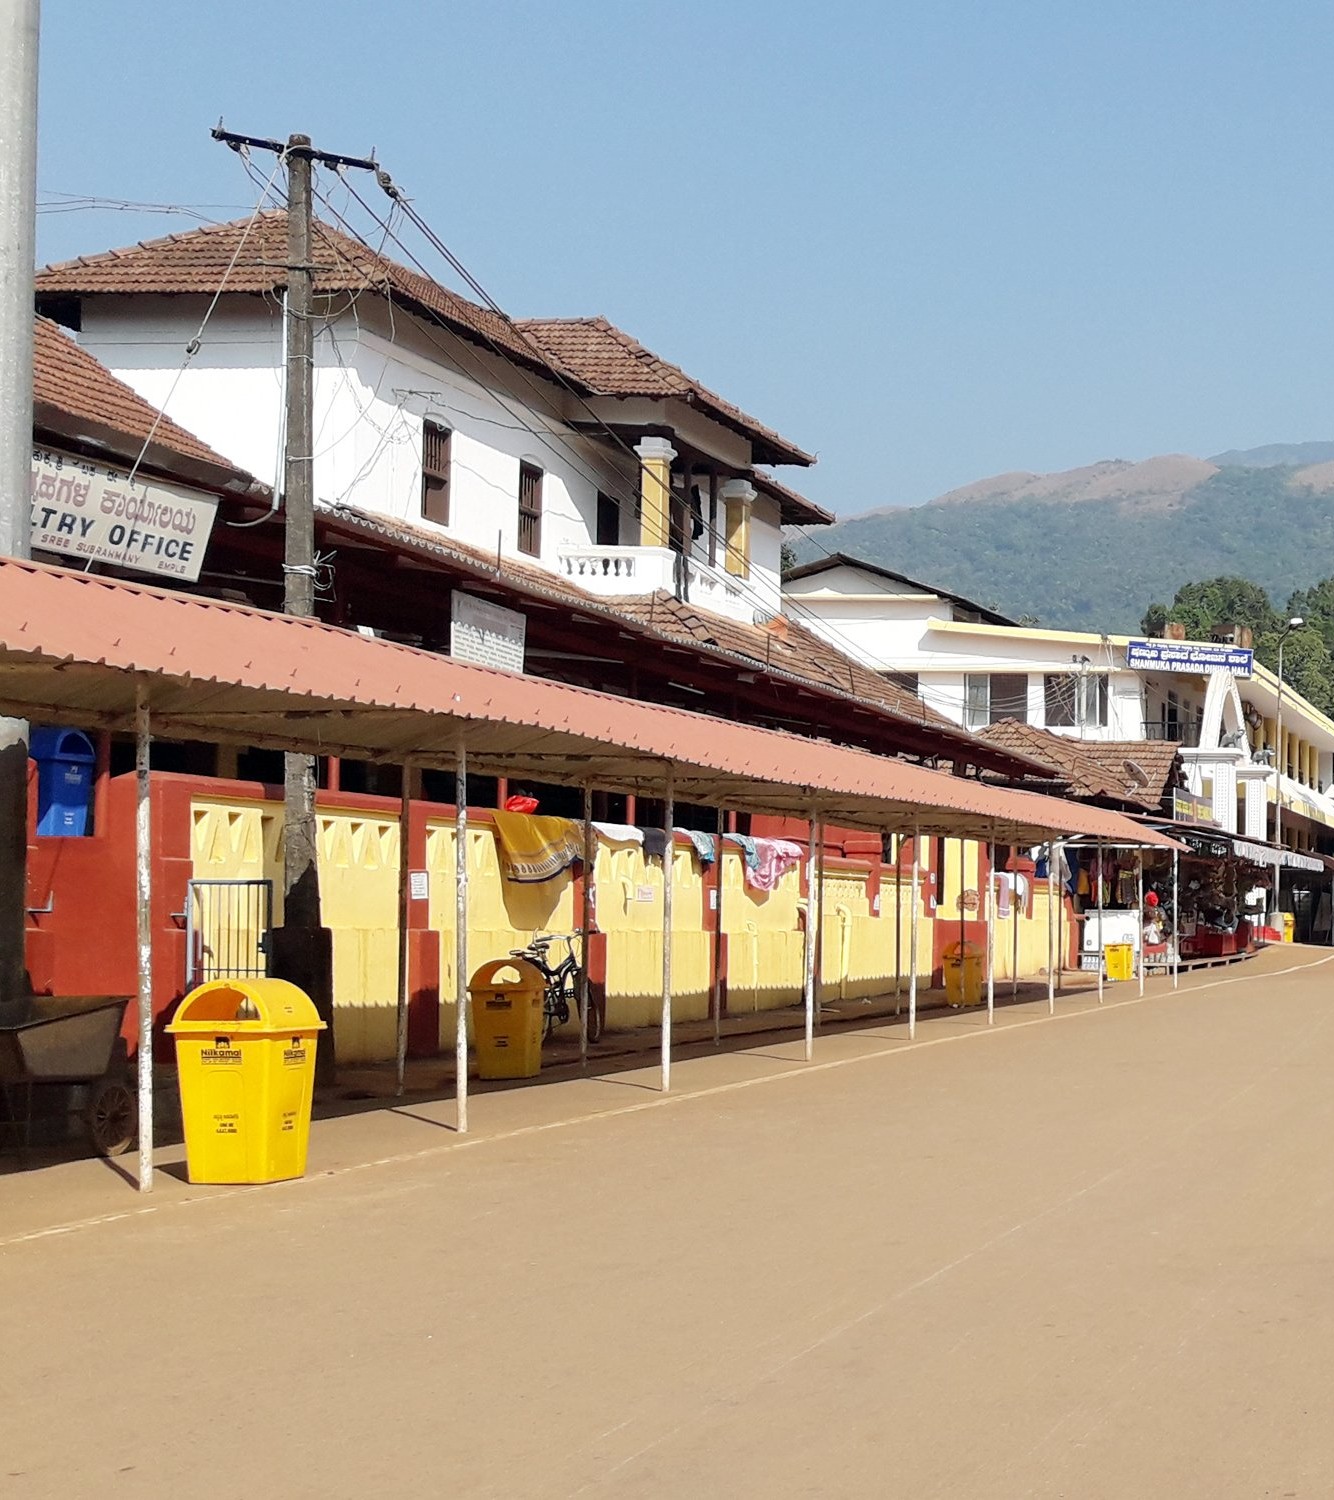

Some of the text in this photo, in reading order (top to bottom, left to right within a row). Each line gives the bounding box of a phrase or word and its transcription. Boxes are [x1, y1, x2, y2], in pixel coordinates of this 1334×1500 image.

[41, 534, 70, 548] SREE
[108, 524, 194, 562] OFFICE
[1130, 658, 1170, 671] SHANMUKA
[1171, 661, 1204, 673] PRASADA
[1231, 665, 1250, 676] HALL
[200, 1048, 242, 1057] Nilkamal
